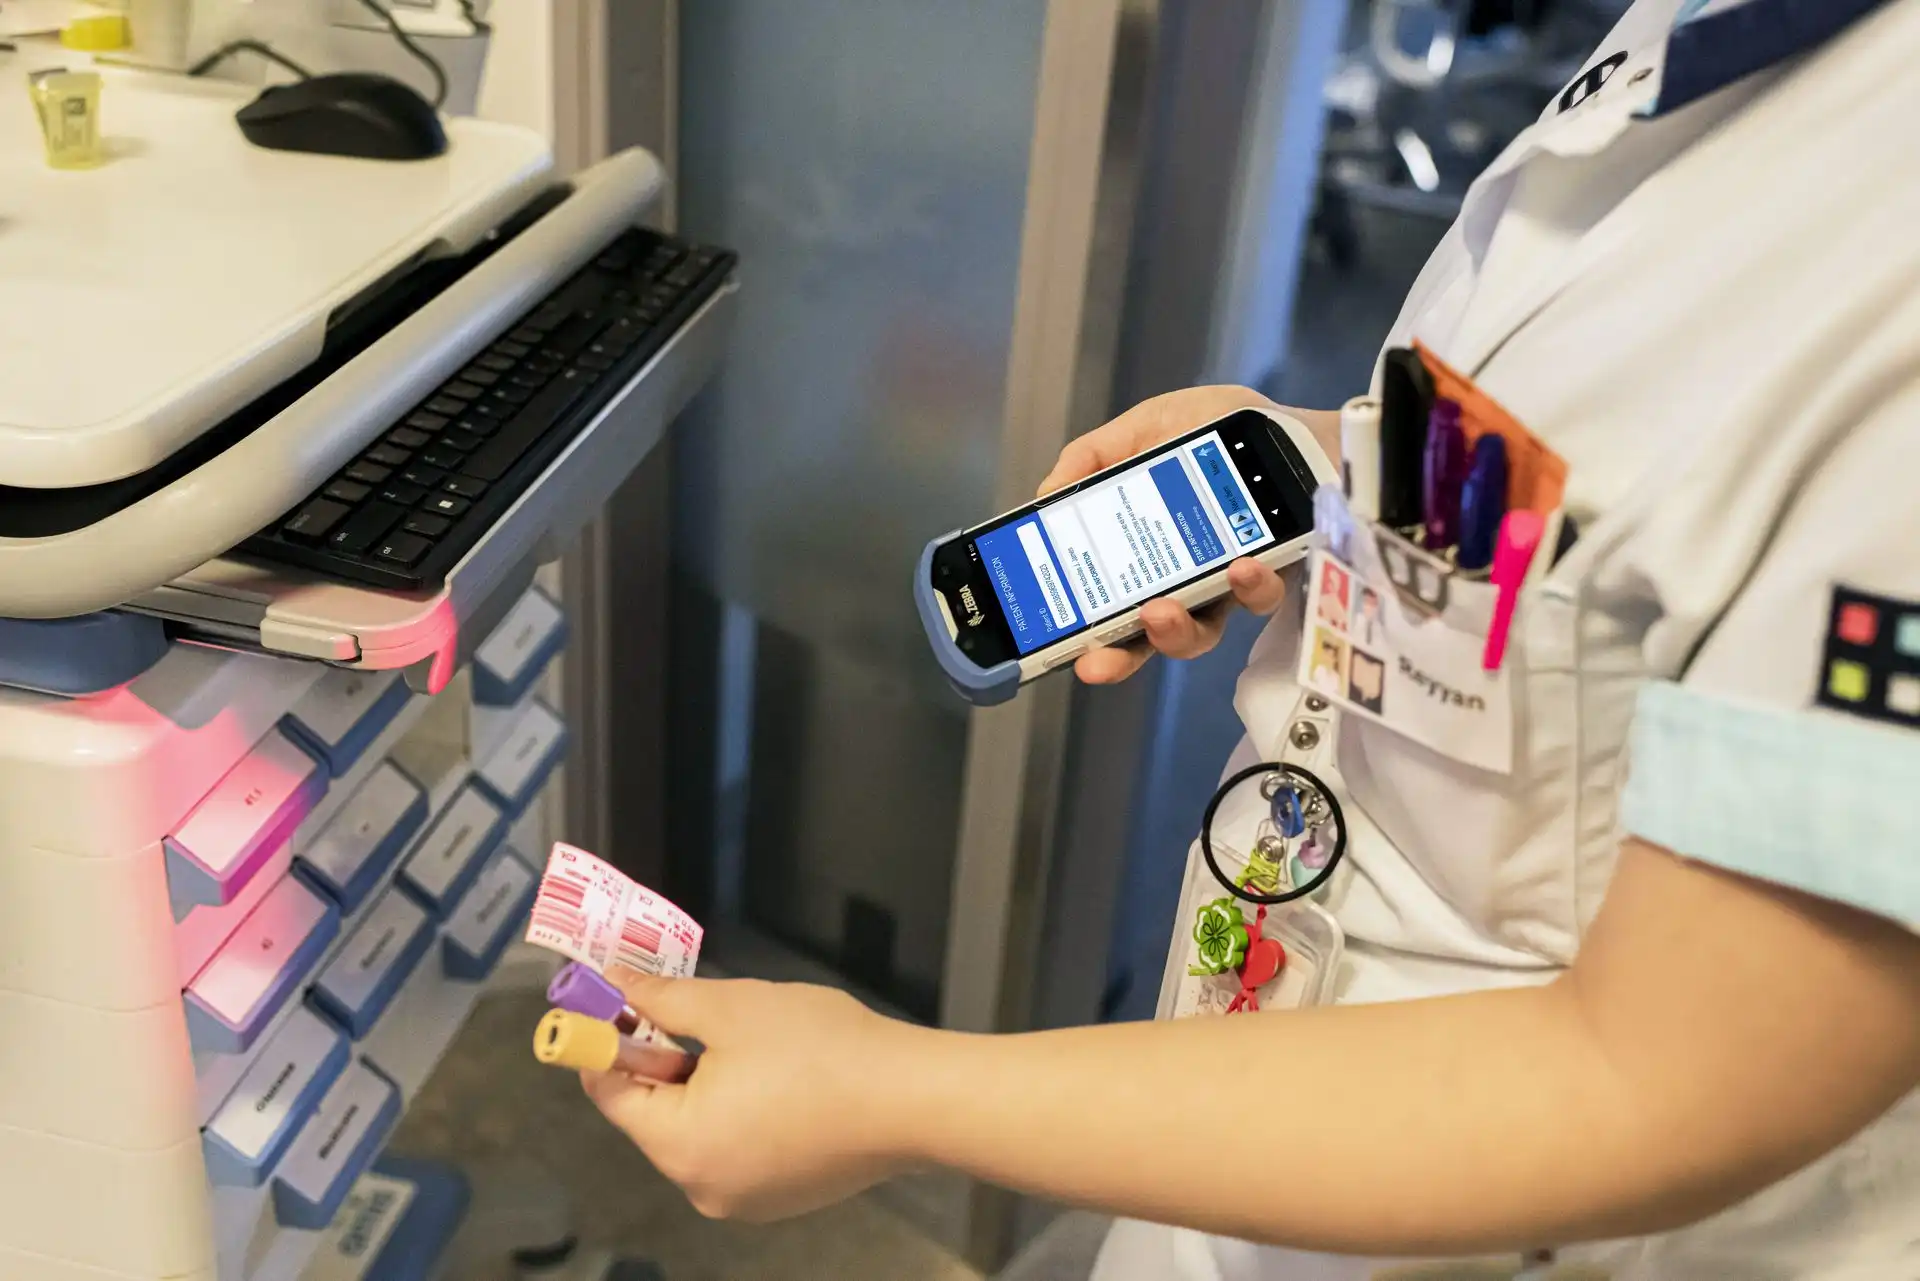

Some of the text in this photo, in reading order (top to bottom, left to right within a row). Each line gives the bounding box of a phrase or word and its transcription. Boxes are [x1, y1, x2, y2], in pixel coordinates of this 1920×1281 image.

[1175, 511, 1197, 546] INFORMATION
[1192, 544, 1205, 562] STAFF
[991, 555, 1027, 631] PATIENT INFORMATION
[1082, 550, 1110, 604] BLOOD INFORMATION
[959, 584, 978, 613] ZEBRA
[1038, 606, 1054, 632] Patient ID
